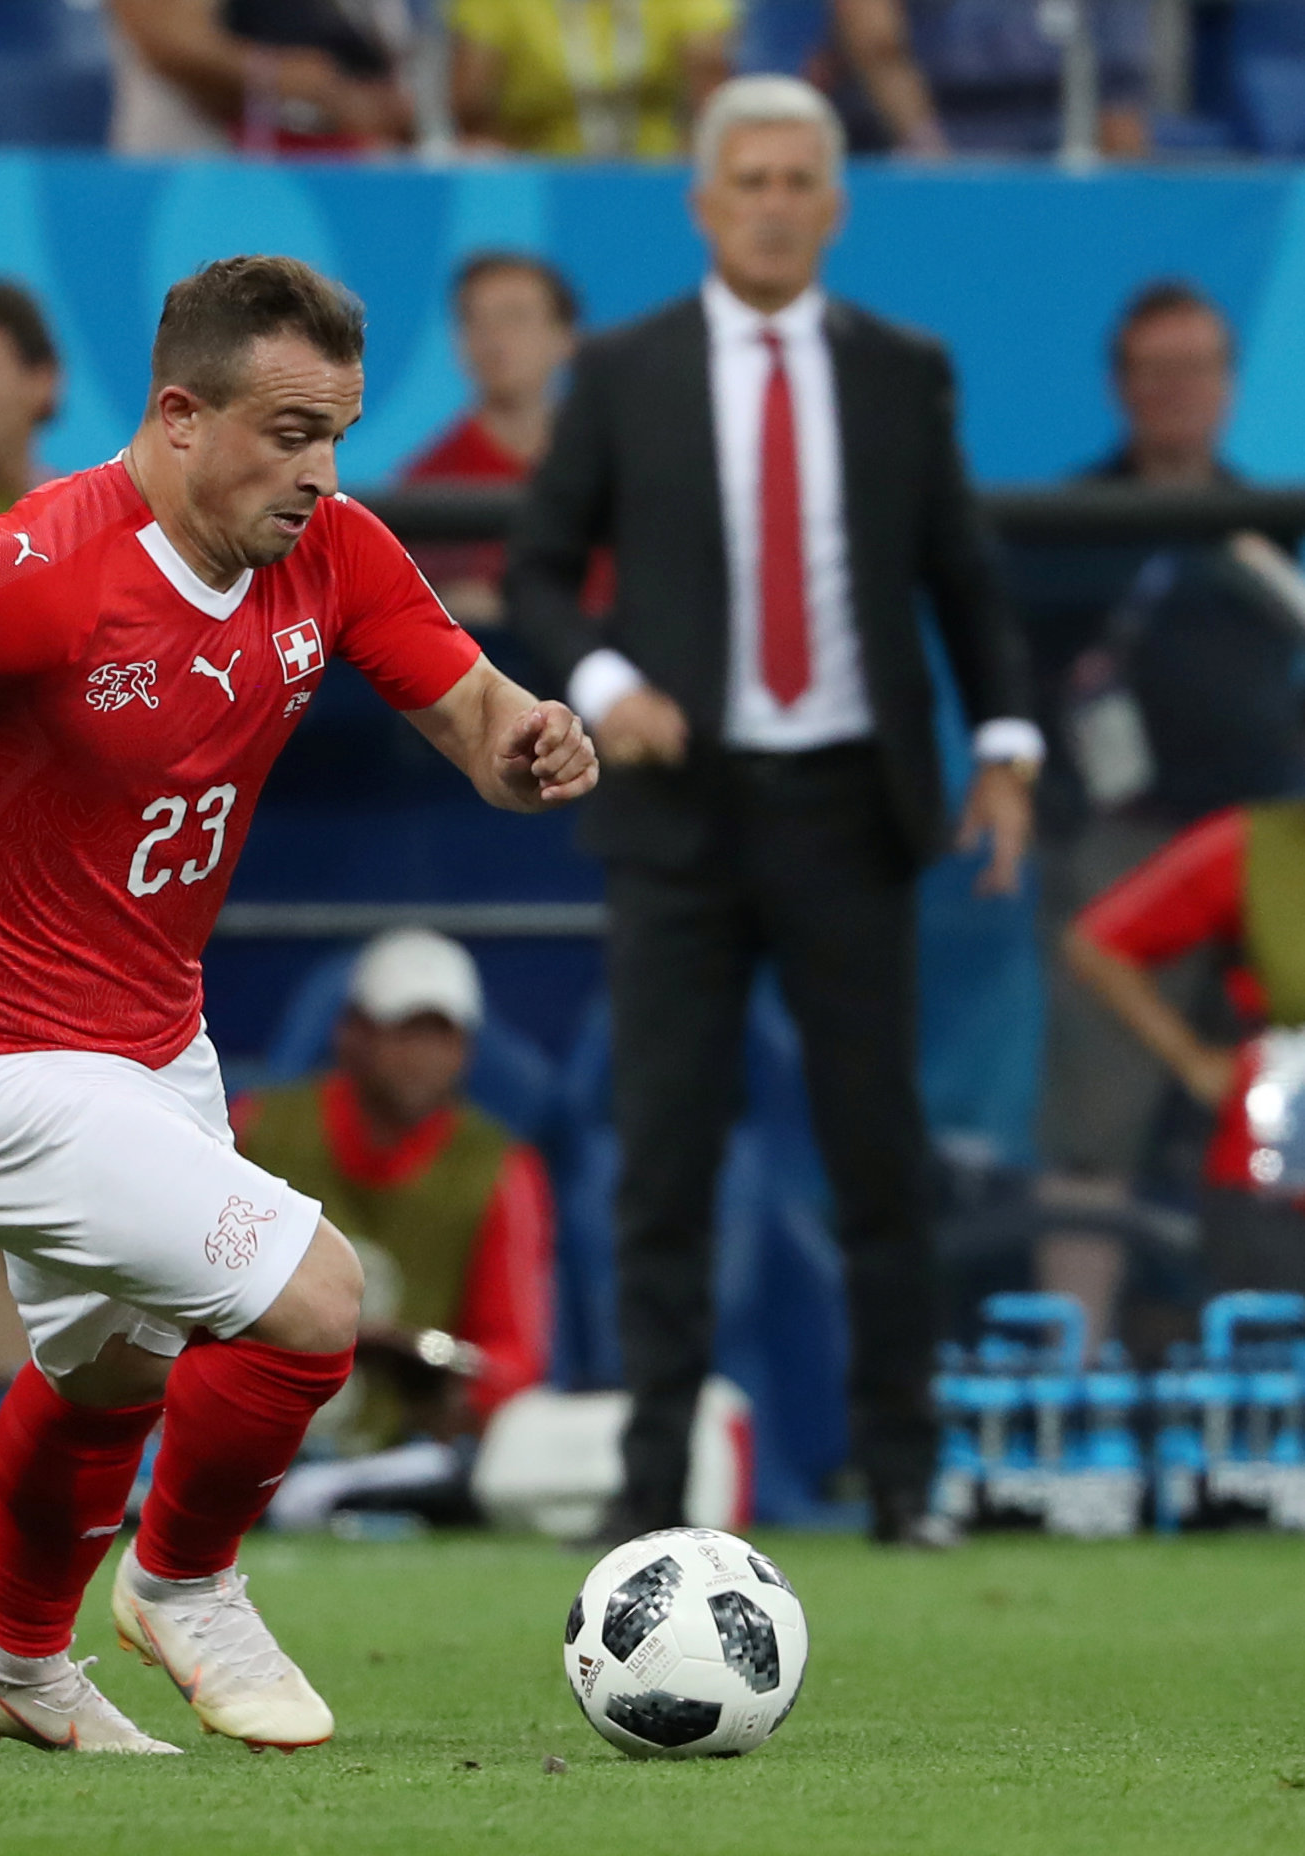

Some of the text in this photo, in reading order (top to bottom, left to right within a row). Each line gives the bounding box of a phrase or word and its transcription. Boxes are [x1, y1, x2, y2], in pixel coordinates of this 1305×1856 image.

[127, 782, 237, 897] 23
[625, 1635, 662, 1673] TELSTAR
[584, 1658, 605, 1698] adidas
